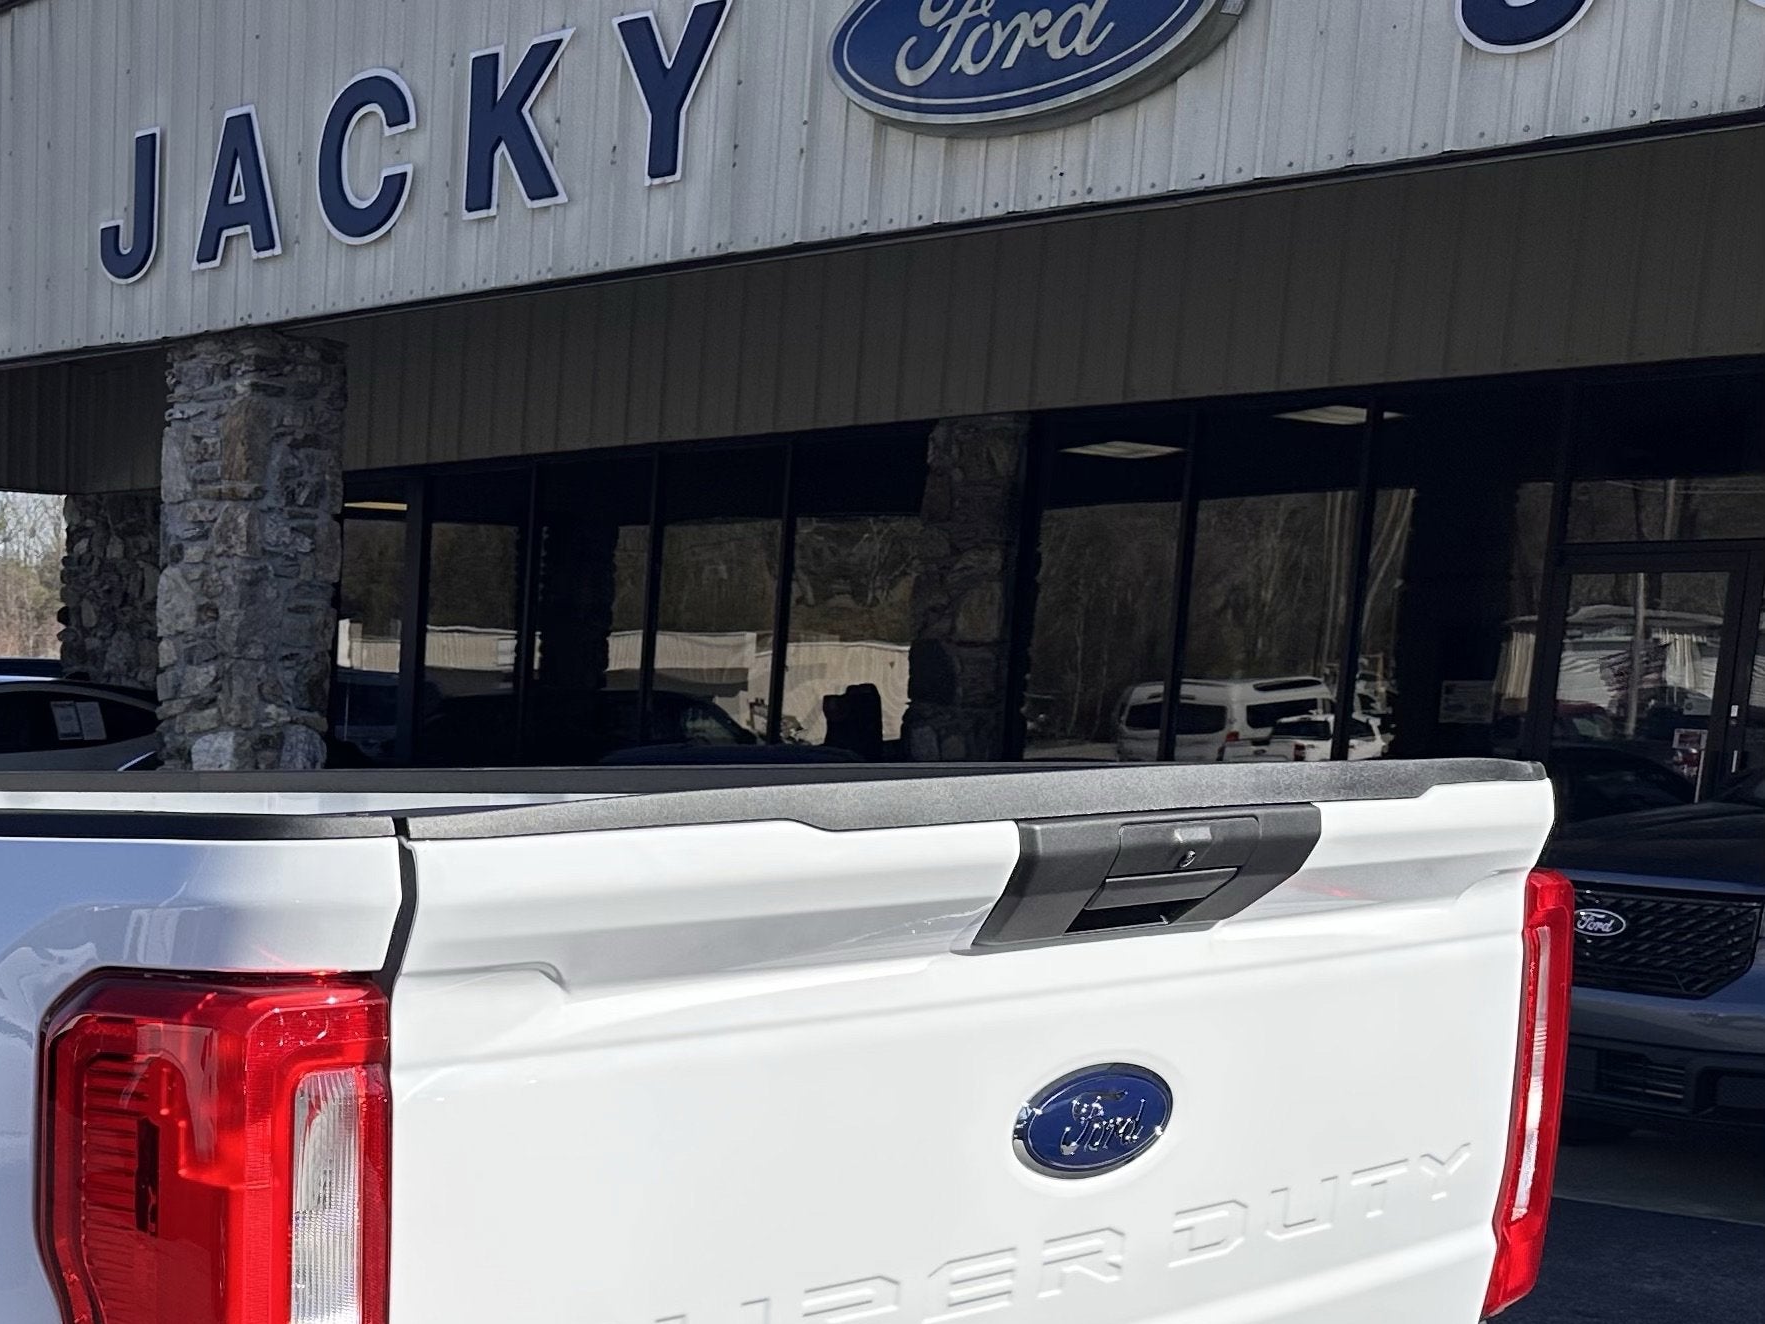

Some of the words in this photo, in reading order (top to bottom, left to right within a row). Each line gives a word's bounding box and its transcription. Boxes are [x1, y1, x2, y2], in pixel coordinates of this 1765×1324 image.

[895, 0, 1115, 88] Ford
[100, 0, 733, 285] JACKY
[1576, 911, 1616, 933] Ford
[1059, 1089, 1146, 1157] Ford
[1167, 1142, 1473, 1270] DUTY
